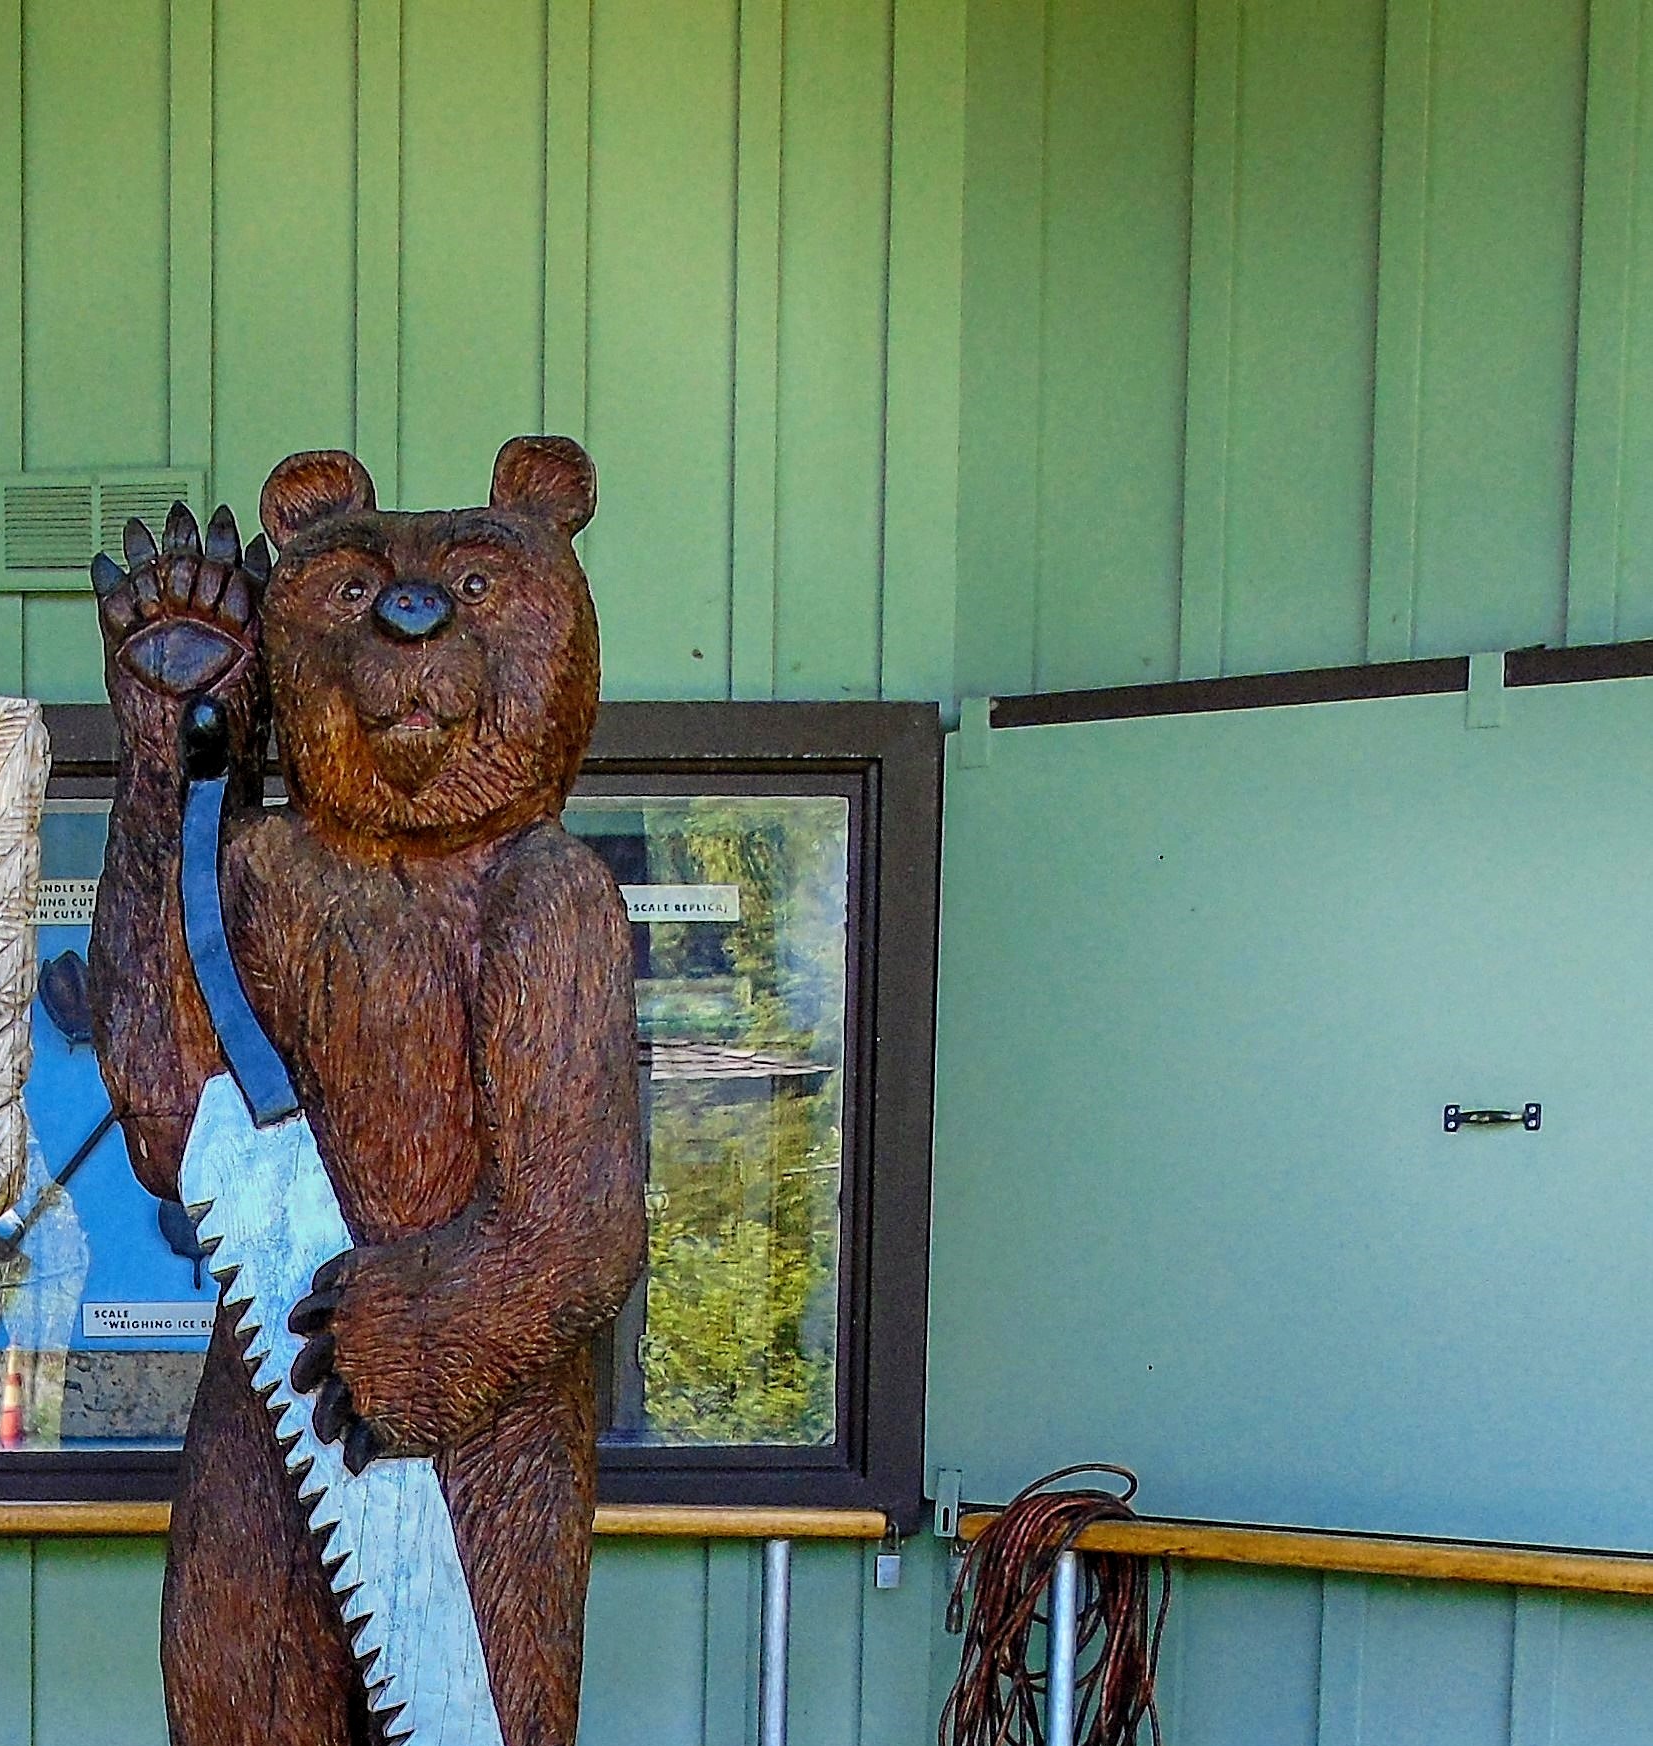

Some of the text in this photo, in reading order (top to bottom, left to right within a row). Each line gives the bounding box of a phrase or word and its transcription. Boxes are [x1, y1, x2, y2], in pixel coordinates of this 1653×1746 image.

[53, 910, 83, 919] CUTS
[93, 1309, 129, 1319] SCALE
[178, 1320, 195, 1329] ICE
